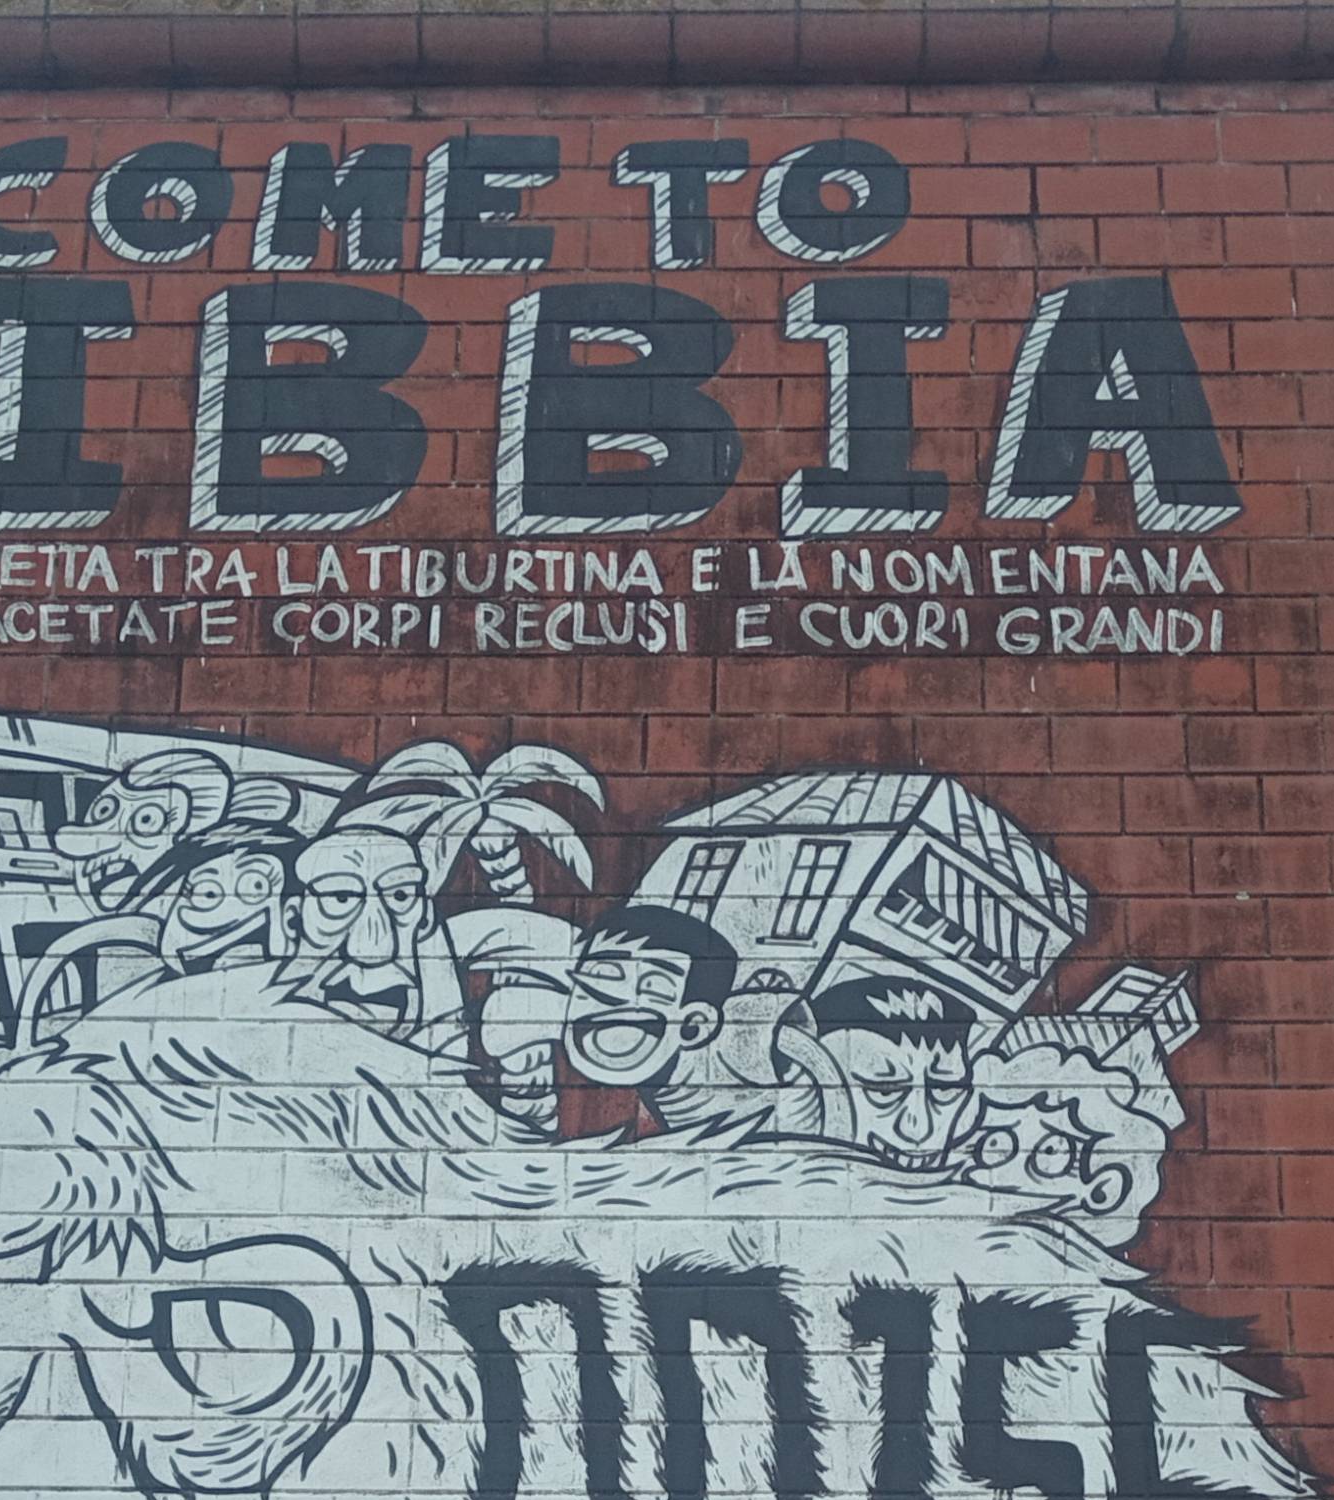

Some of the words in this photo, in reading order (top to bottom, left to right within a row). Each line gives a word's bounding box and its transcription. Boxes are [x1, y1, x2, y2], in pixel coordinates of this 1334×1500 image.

[610, 136, 912, 271] TO
[134, 546, 257, 597] TRA
[692, 547, 721, 592] E
[272, 600, 441, 650] CORPI
[475, 600, 689, 653] RECLUSI
[735, 604, 773, 649] E
[799, 601, 969, 652] CUORI
[995, 605, 1225, 656] GRANDI
